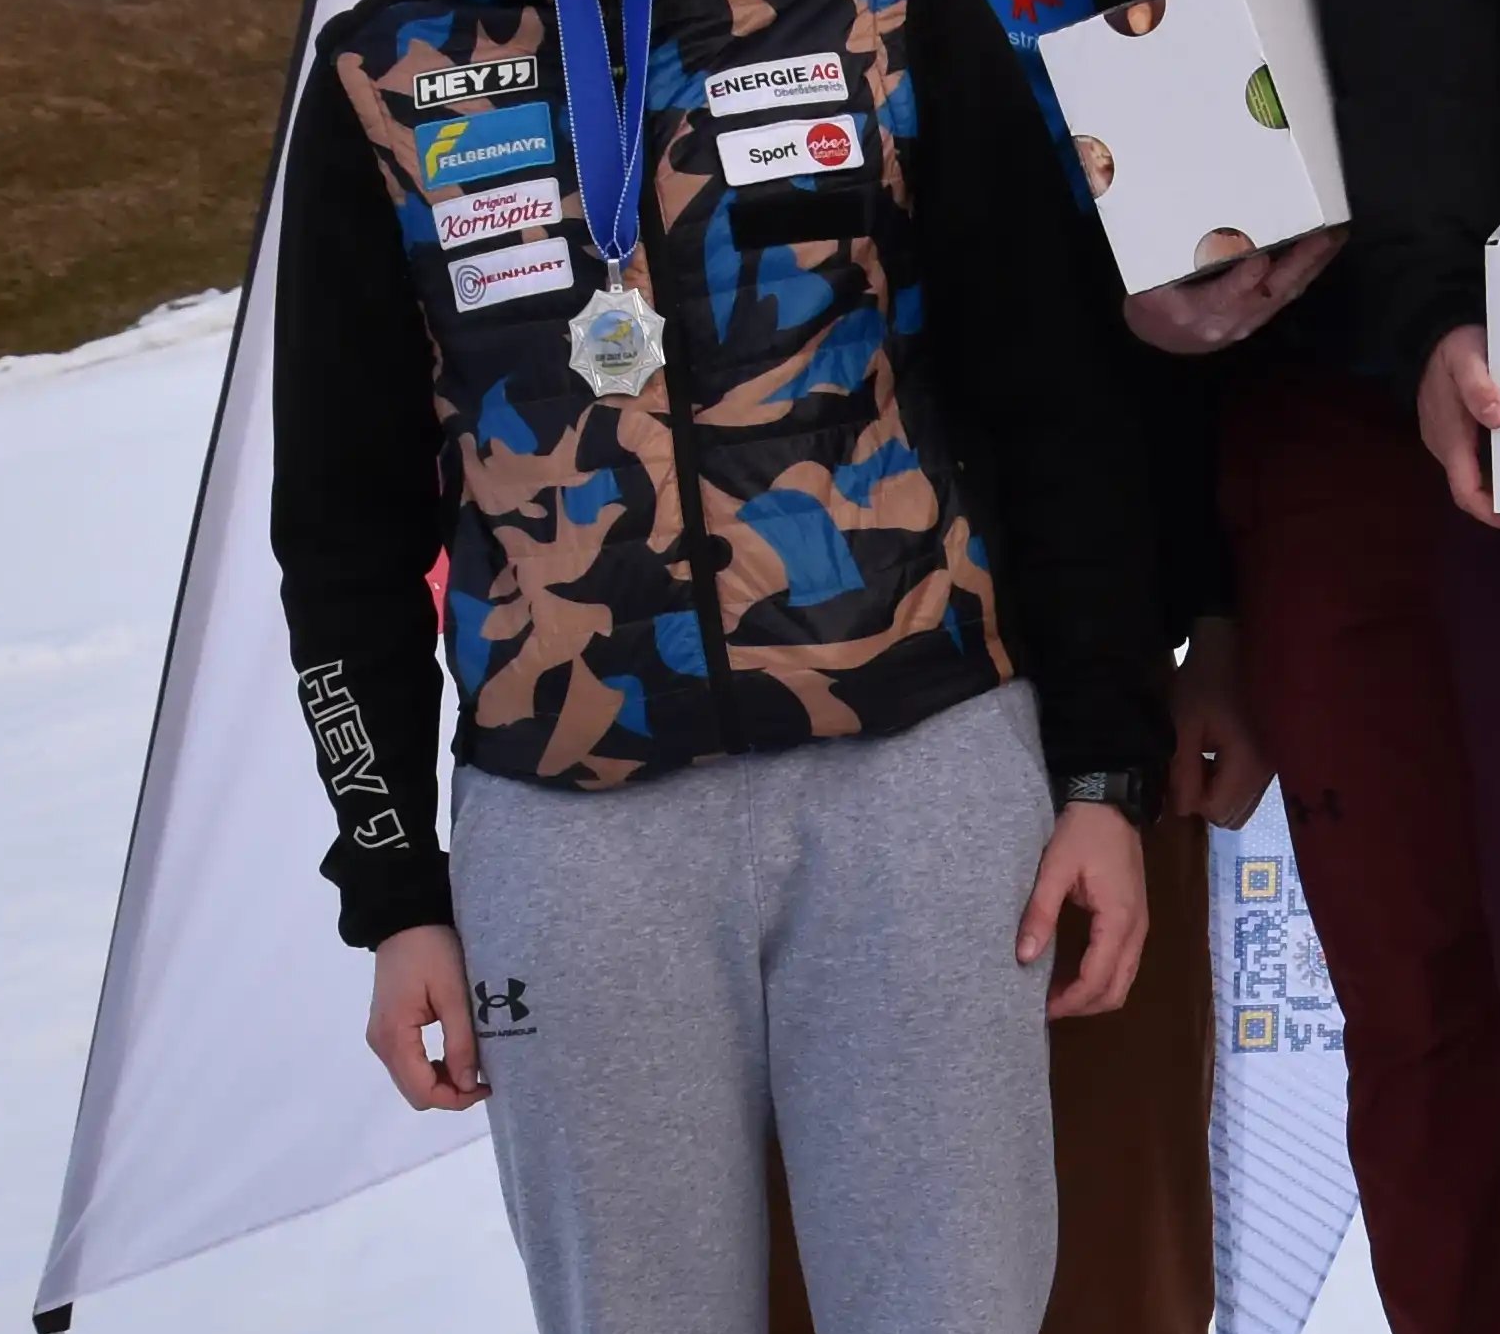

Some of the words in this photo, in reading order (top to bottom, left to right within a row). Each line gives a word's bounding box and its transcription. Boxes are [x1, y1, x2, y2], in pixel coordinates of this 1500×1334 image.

[420, 67, 492, 102] HEY
[439, 137, 546, 169] FELBERMAYR
[749, 142, 798, 165] Sport
[472, 192, 517, 212] Original
[440, 197, 552, 243] Kornspitz
[472, 259, 565, 288] MEINHART
